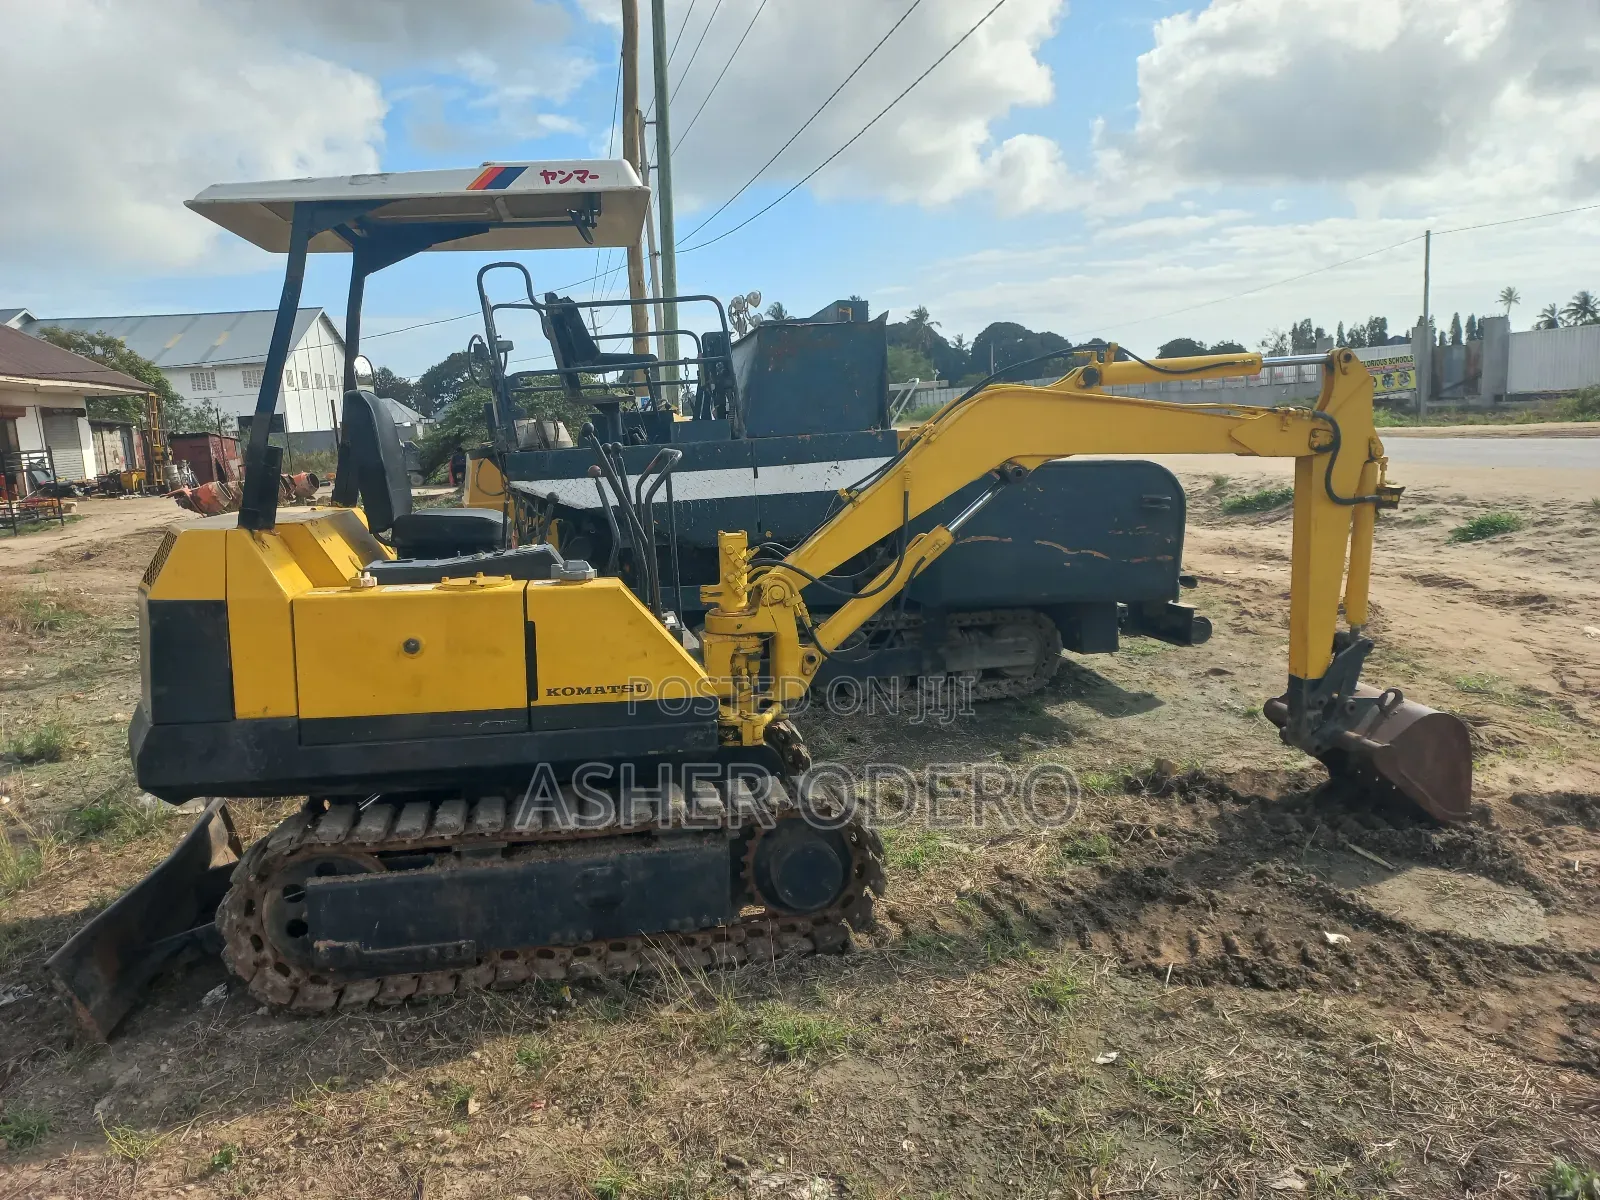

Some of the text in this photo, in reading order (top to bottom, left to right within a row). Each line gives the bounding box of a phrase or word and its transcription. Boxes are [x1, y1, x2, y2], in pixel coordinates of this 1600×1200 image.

[540, 170, 599, 184] ヤンマー
[1389, 355, 1414, 365] SCHOOLS
[546, 684, 648, 696] KOMATSU
